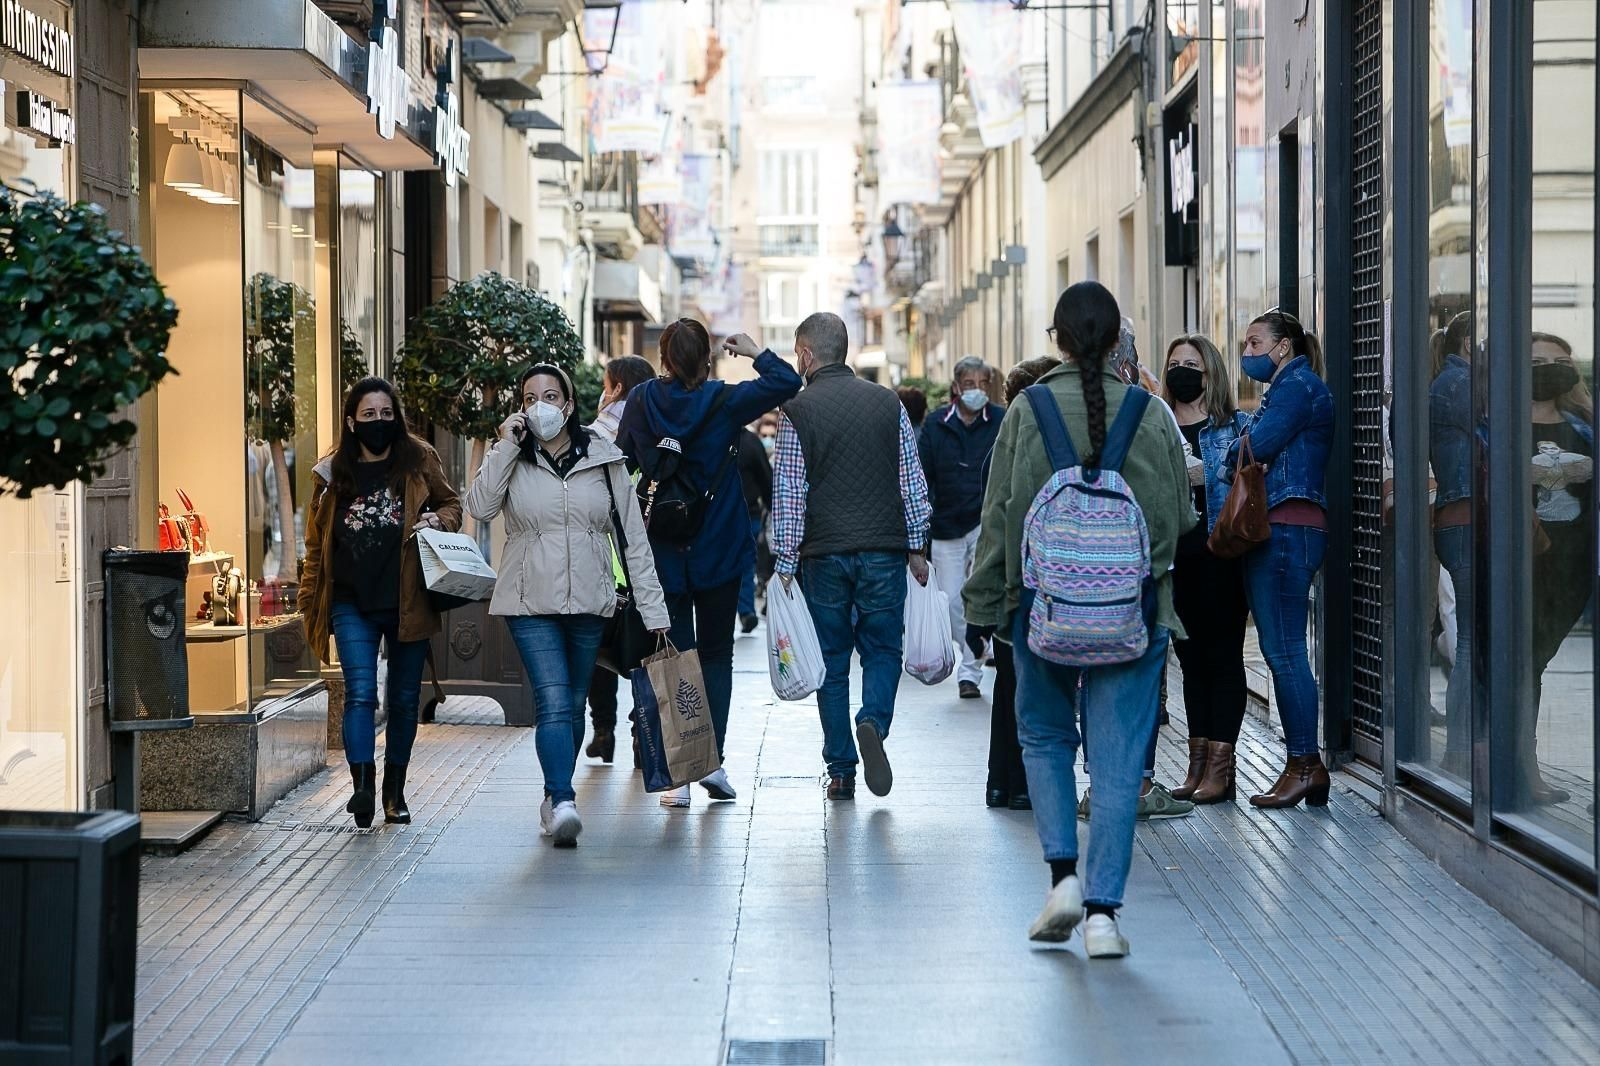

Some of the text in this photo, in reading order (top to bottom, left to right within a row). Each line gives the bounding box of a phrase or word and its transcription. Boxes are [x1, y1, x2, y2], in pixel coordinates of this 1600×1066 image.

[2, 0, 74, 78] intimissimi
[638, 706, 658, 768] springfield
[679, 722, 710, 743] SPRINGFIELD
